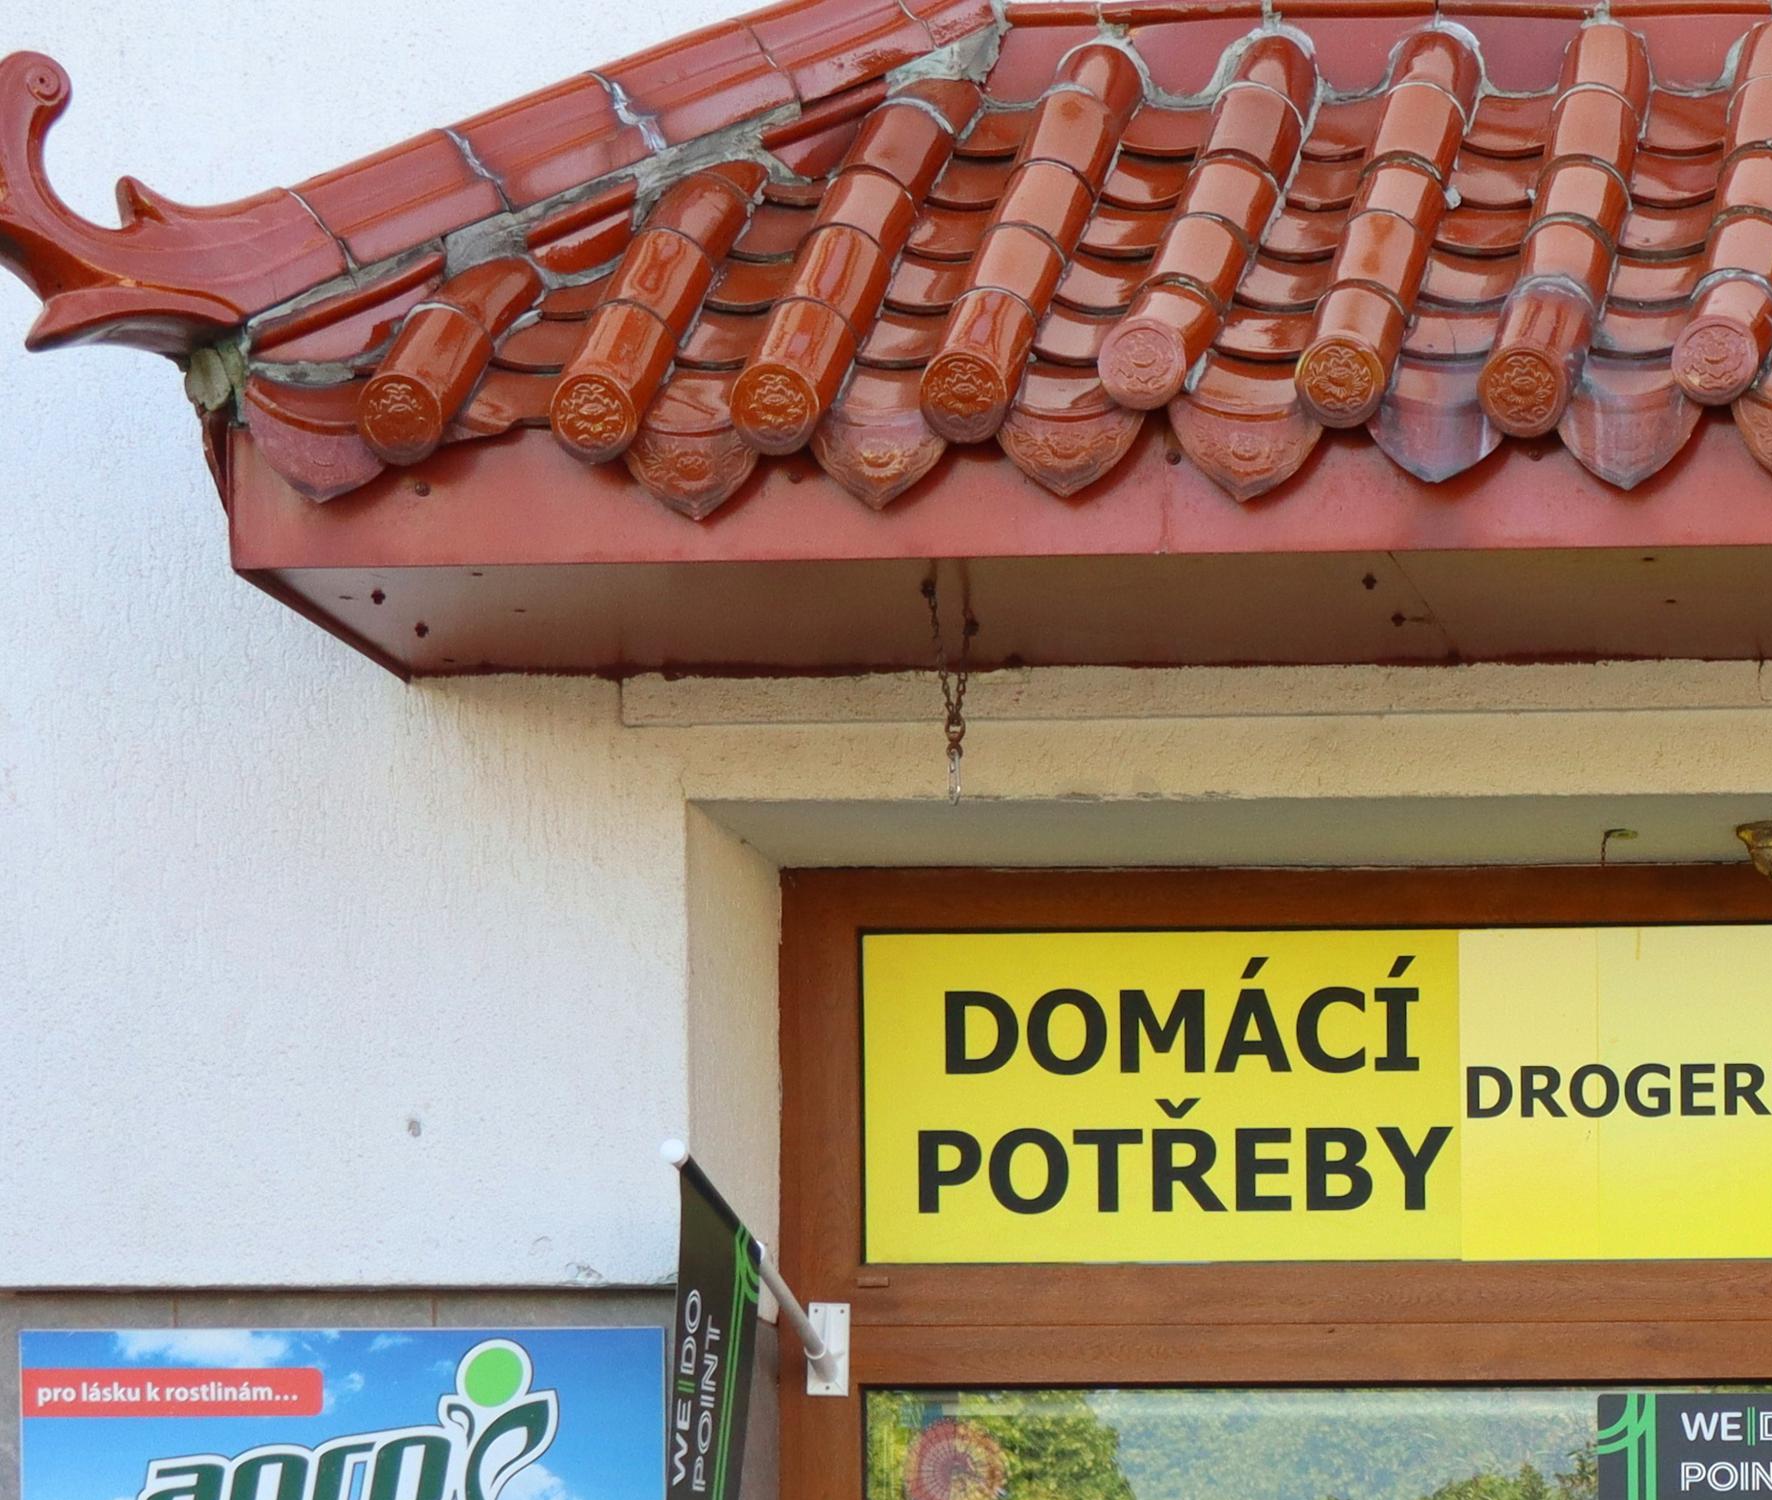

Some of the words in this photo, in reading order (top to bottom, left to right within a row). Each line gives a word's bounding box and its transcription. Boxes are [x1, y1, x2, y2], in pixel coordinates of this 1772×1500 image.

[944, 956, 1421, 1076] DOMÁCÍ
[917, 1098, 1454, 1217] POTŘEBY
[36, 1386, 75, 1408] pro
[81, 1380, 137, 1403] lásku
[143, 1381, 159, 1402] k
[691, 1314, 723, 1493] POINT
